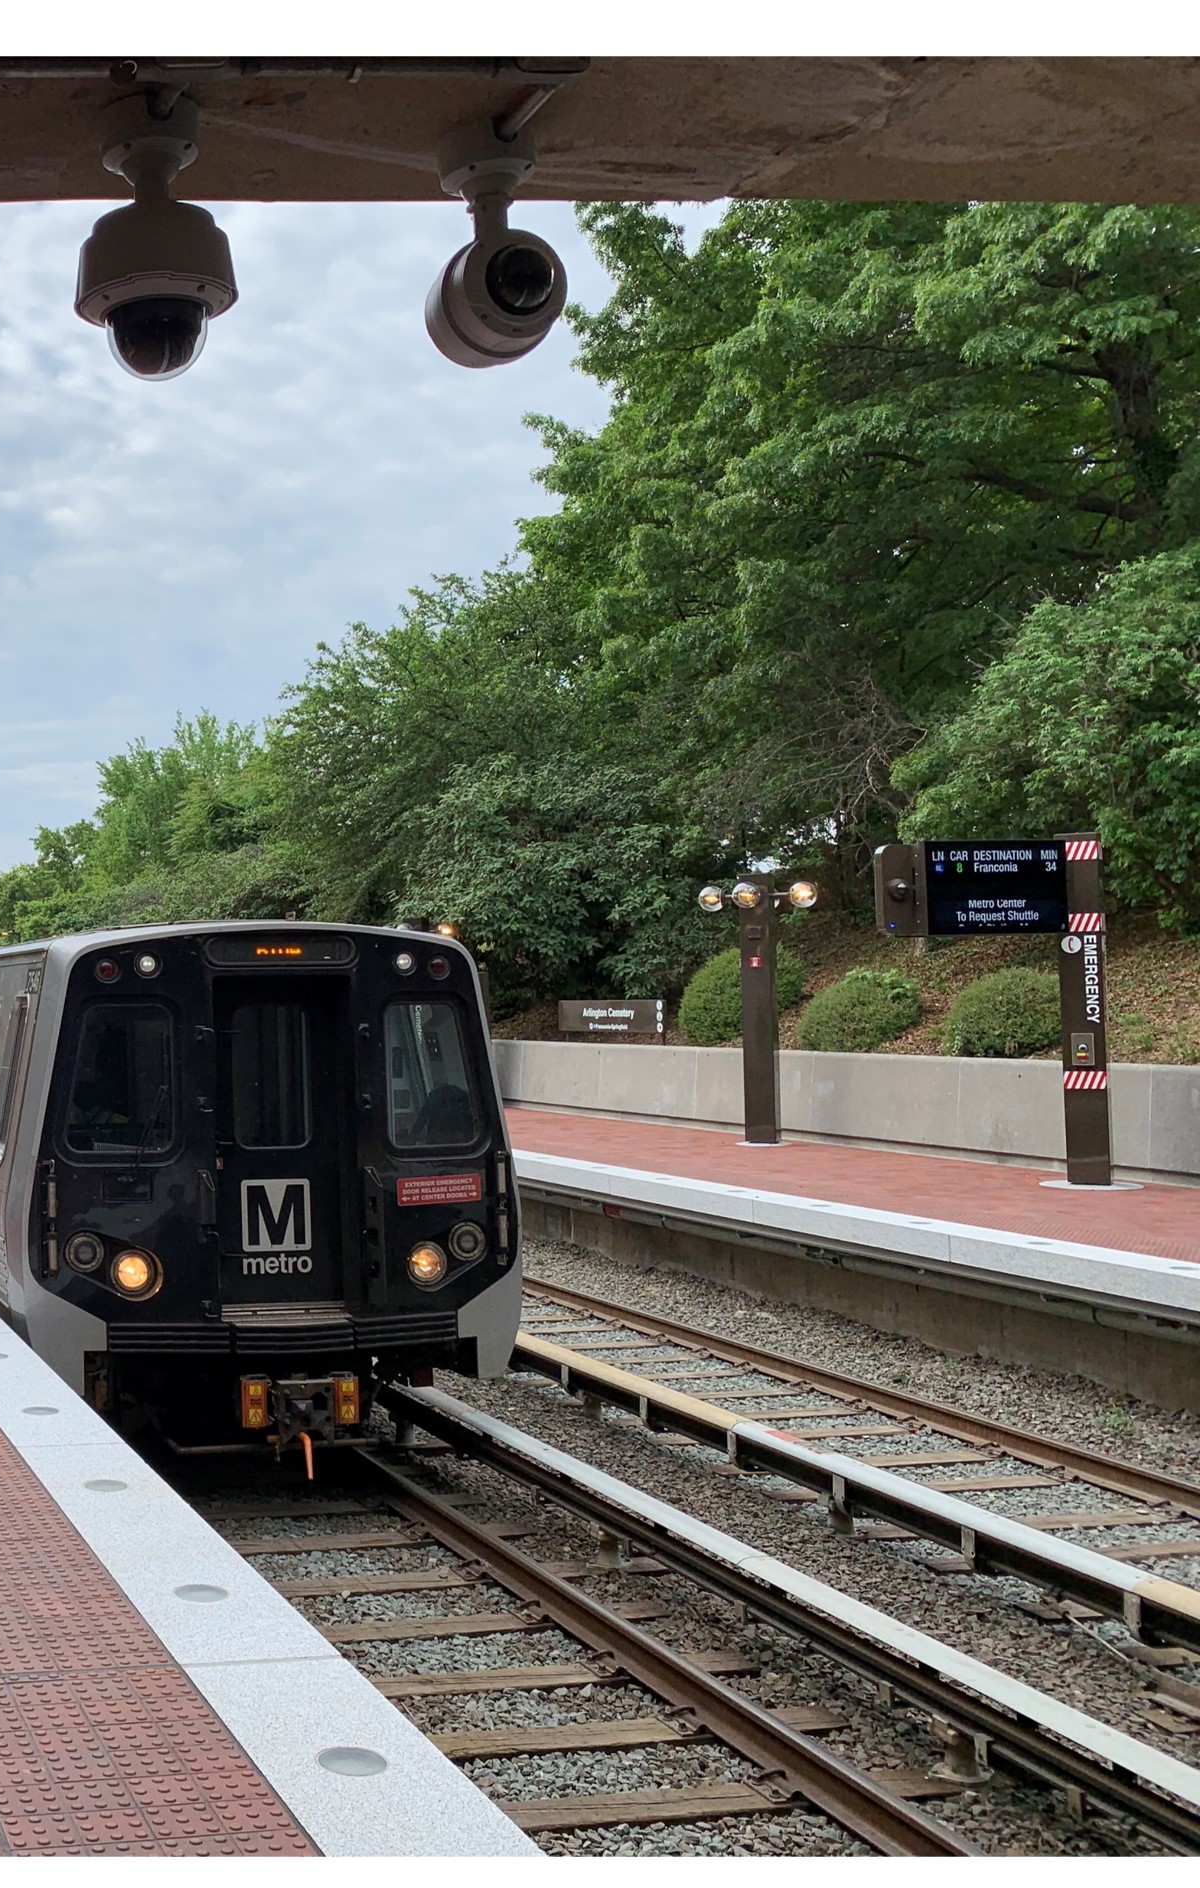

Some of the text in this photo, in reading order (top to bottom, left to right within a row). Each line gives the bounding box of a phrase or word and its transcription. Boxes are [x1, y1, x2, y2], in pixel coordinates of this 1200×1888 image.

[932, 850, 1058, 861] LN CAR DESTINATION MIN
[956, 863, 962, 873] 8
[974, 862, 1018, 872] Franconia
[1045, 862, 1057, 872] 34
[969, 900, 1026, 909] Metro Center
[956, 910, 1039, 923] To Request Shuttle
[1084, 935, 1100, 1023] EMERGENCY
[583, 1008, 634, 1020] Arlington Cemetery
[247, 1184, 306, 1245] M
[243, 1253, 312, 1274] metro
